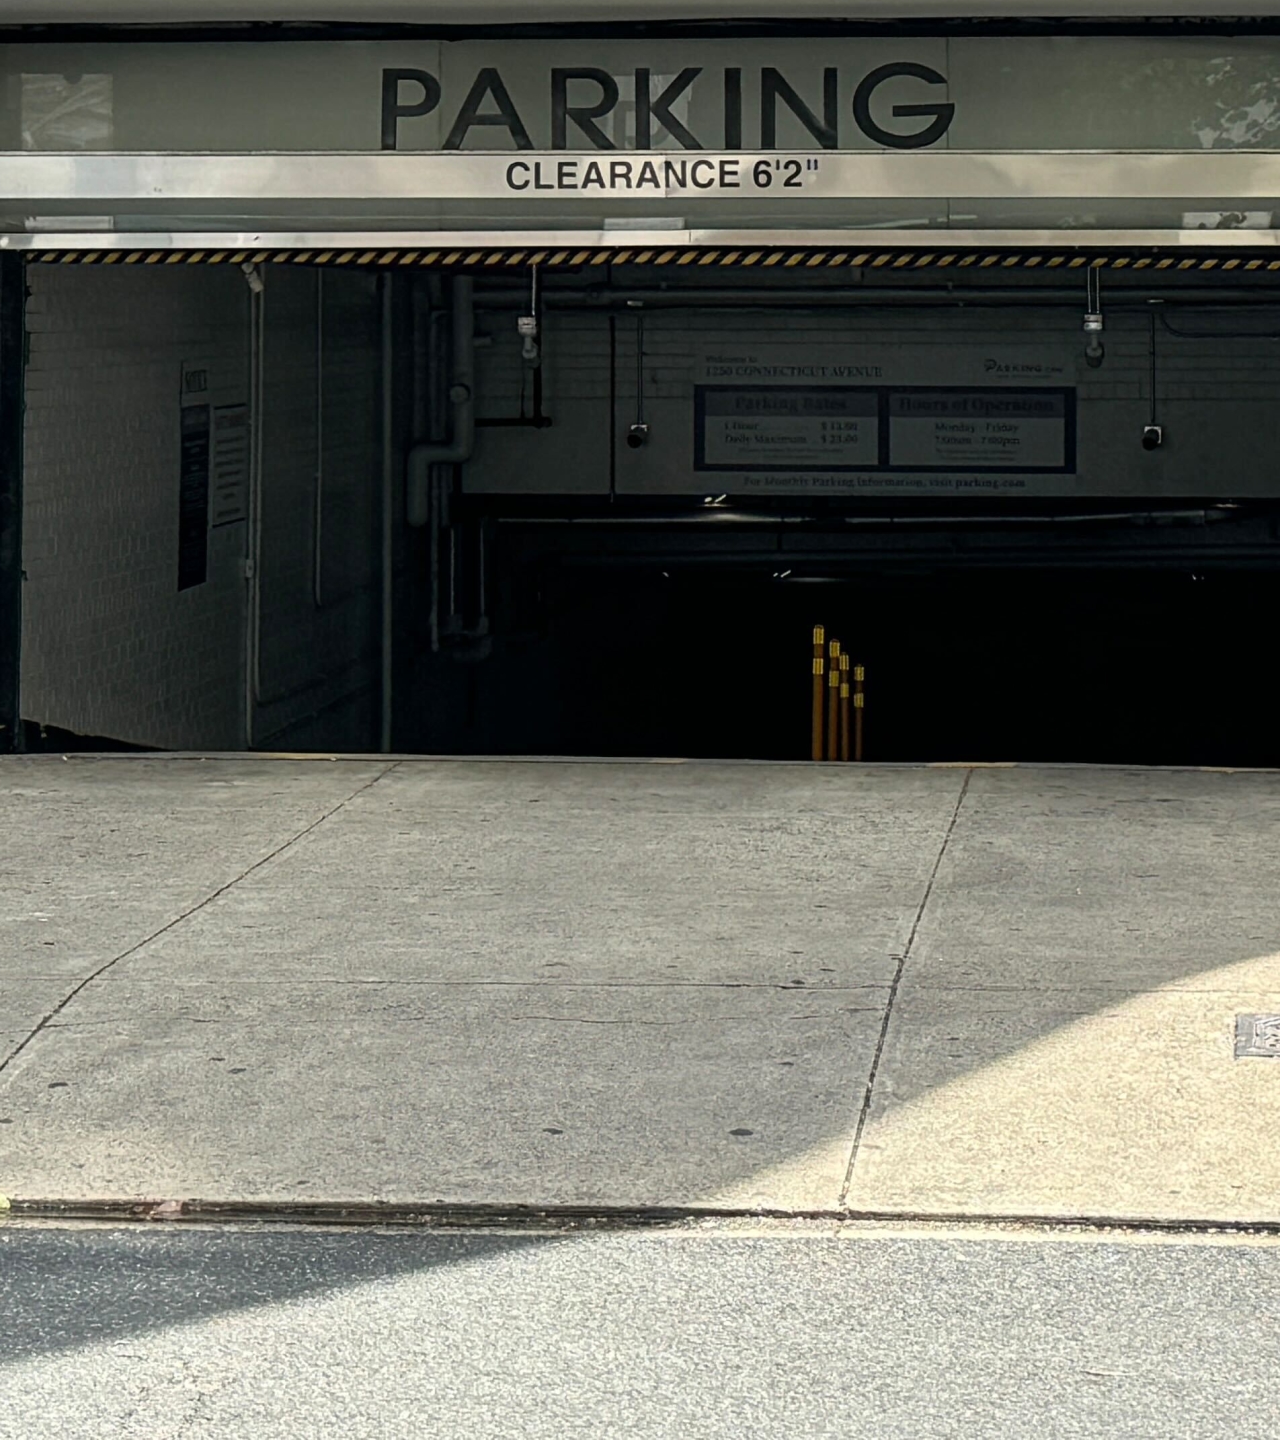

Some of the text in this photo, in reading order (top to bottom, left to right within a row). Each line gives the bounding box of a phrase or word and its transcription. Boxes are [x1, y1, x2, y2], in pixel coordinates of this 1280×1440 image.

[380, 61, 955, 150] PARKING
[506, 157, 819, 190] CLEARANCE 6'2"
[736, 367, 827, 377] CONNECTICUT
[832, 367, 882, 377] AVENUE
[735, 397, 847, 412] Parking Rates
[899, 397, 1054, 414] Hours of Operation
[935, 423, 975, 433] Monday
[986, 423, 1019, 433] Friday
[744, 477, 761, 486] For
[813, 477, 854, 488] Parking
[955, 478, 1026, 489] parking.com
